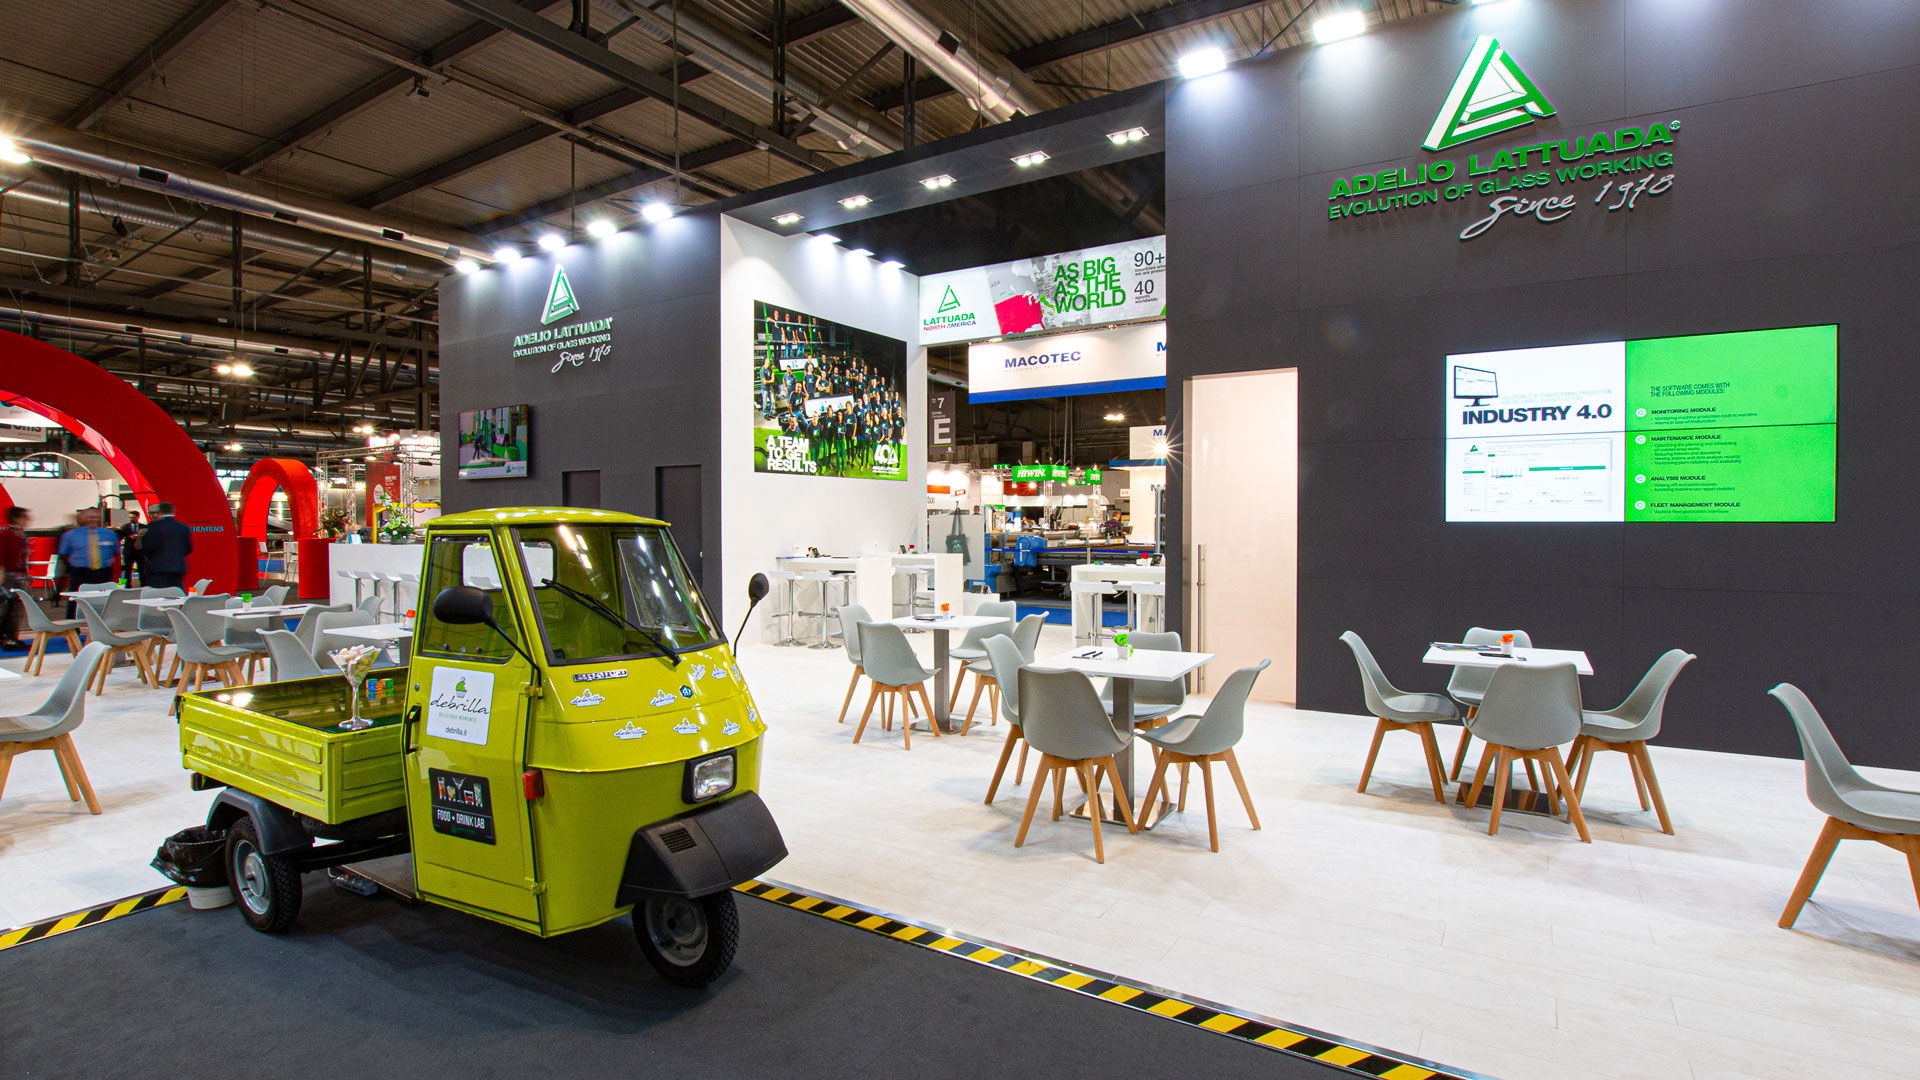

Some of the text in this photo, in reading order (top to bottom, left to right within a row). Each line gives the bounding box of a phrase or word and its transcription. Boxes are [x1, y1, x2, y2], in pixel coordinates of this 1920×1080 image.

[1329, 160, 1455, 200] ADELIO
[1329, 151, 1674, 219] EVOLUTION OF GLASS WORKING
[1459, 193, 1576, 240] Since
[1054, 256, 1116, 281] AS BIG
[1134, 250, 1165, 267] 90+
[1055, 272, 1121, 297] AS THE
[1134, 279, 1154, 295] 40
[1054, 289, 1126, 314] WORLD
[924, 312, 975, 326] LATTUADA
[513, 334, 611, 358] EVOLUTION OF GLASS WORKING
[514, 330, 552, 347] ADELIO
[552, 352, 584, 373] Since
[1005, 352, 1082, 368] MACOTEC
[938, 398, 944, 408] 7
[1462, 404, 1612, 425] INDUSTRY 4.0
[934, 418, 952, 444] E
[766, 434, 810, 450] A TEAM
[768, 447, 808, 461] TO GET
[767, 458, 818, 473] RESULTS
[1017, 469, 1046, 478] HIWIN
[430, 694, 489, 714] debrilla
[446, 726, 468, 736] debrilla.it
[437, 809, 450, 822] FOOD
[456, 813, 474, 826] DRINK
[474, 816, 484, 829] LAB
